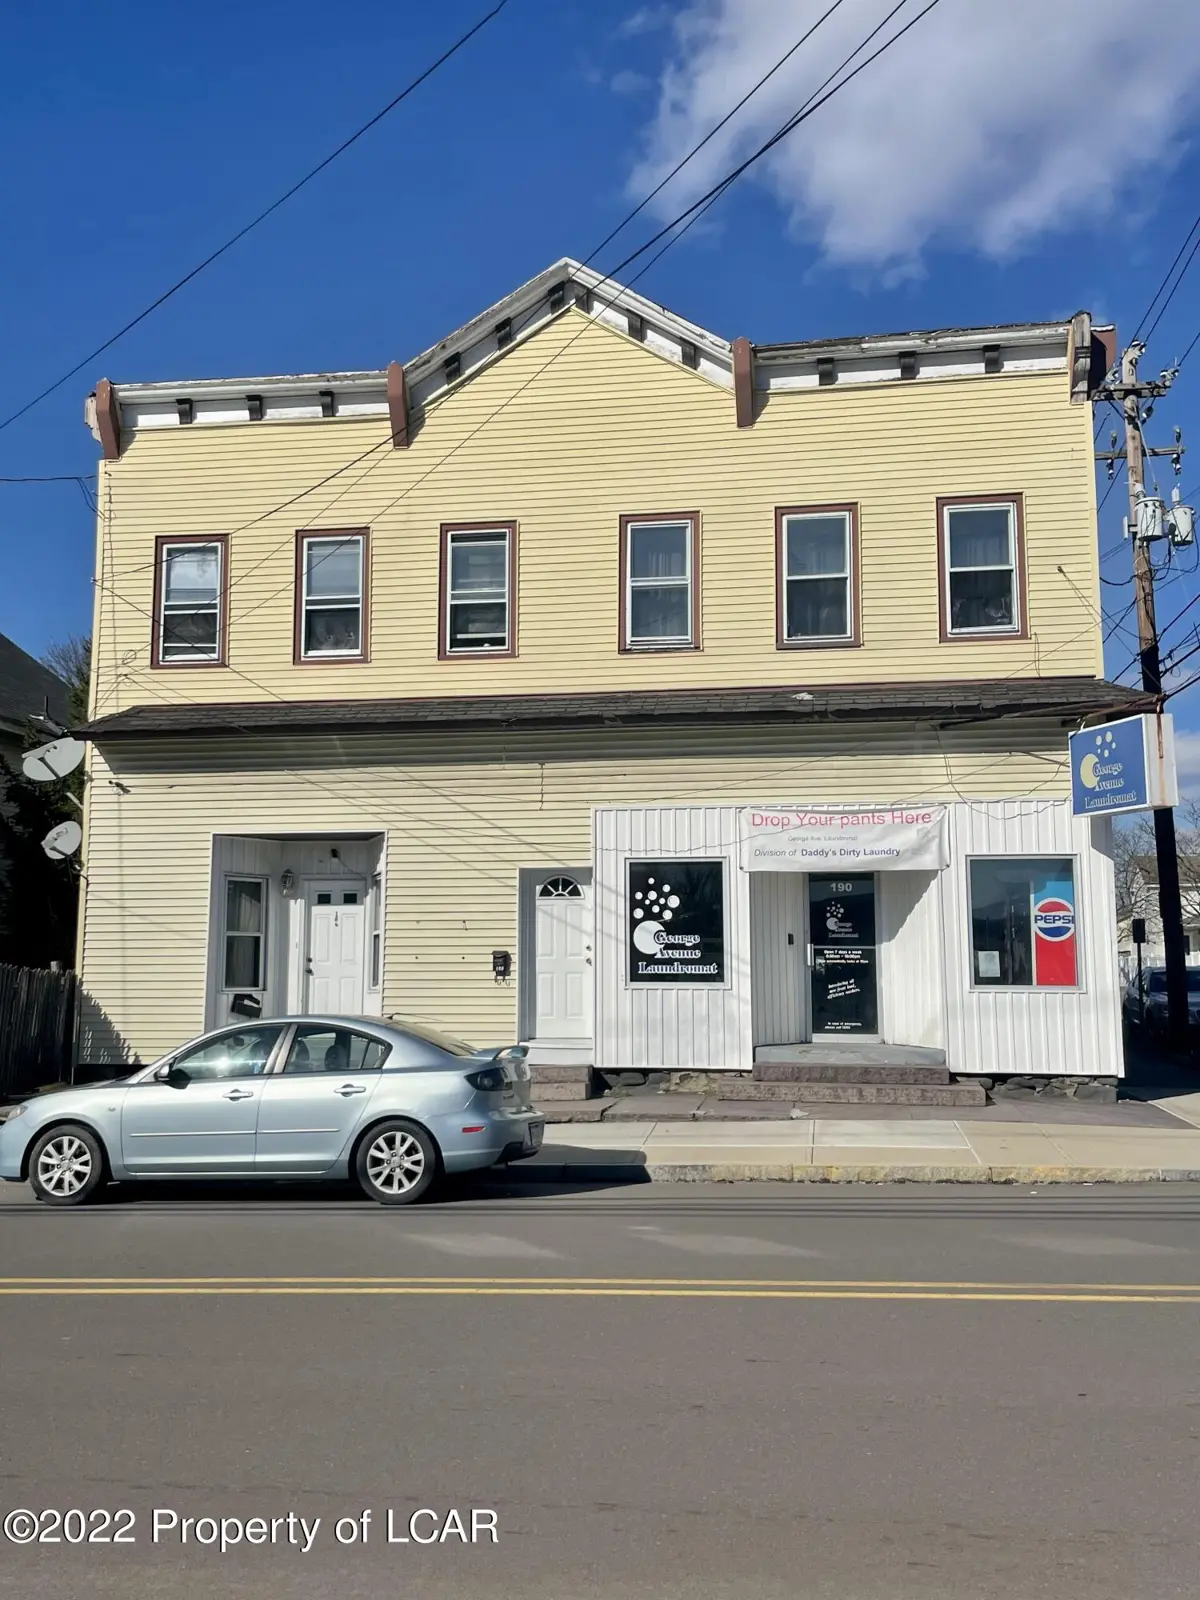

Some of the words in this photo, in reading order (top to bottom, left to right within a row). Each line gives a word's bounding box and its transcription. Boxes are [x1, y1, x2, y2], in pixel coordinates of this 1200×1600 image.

[752, 813, 791, 830] Drop
[796, 812, 835, 827] Your
[840, 811, 886, 830] pants
[891, 810, 932, 825] Here
[754, 849, 787, 857] Division
[788, 849, 797, 857] of
[801, 848, 837, 858] Daddy's
[839, 848, 861, 858] Dirty
[863, 847, 901, 858] Laundry
[830, 882, 853, 892] 190
[1034, 914, 1075, 924] PEPSI
[654, 931, 701, 946] George
[654, 948, 702, 959] Avenue
[638, 961, 719, 974] Laundromat
